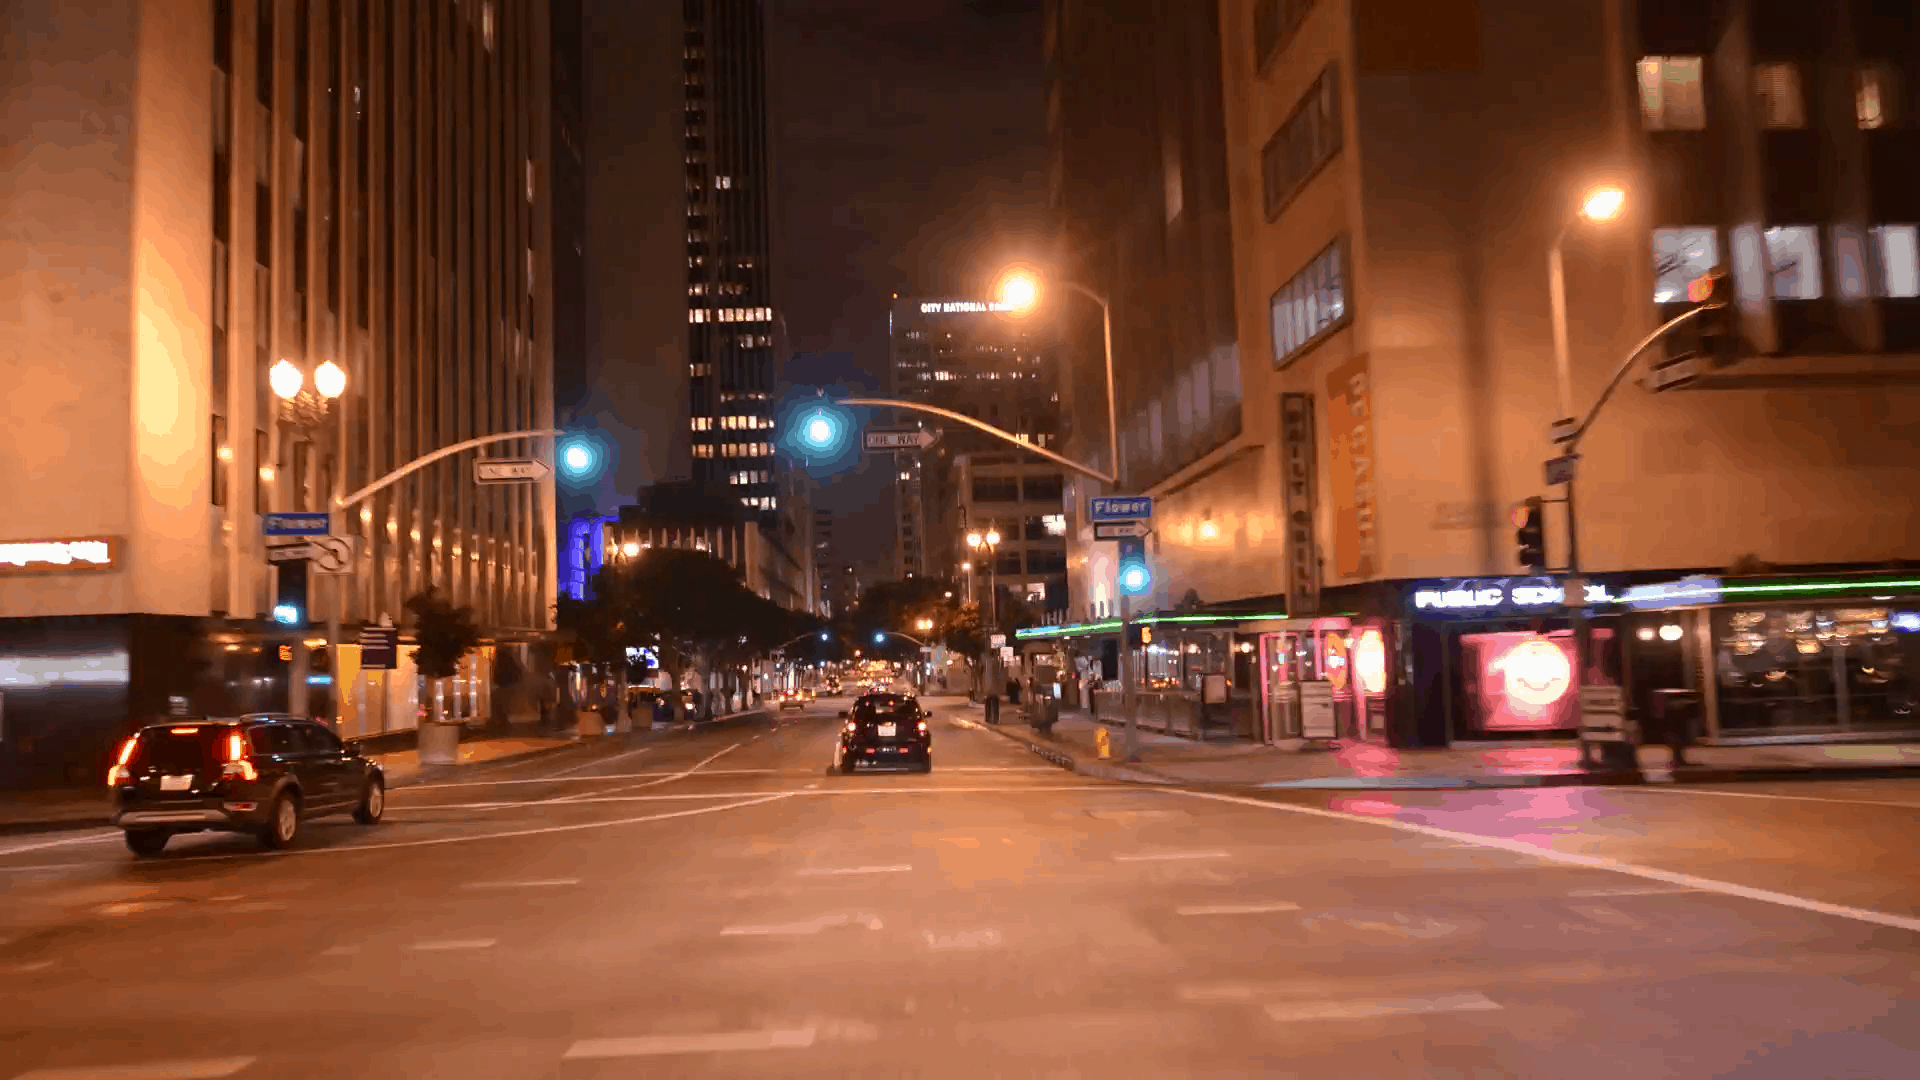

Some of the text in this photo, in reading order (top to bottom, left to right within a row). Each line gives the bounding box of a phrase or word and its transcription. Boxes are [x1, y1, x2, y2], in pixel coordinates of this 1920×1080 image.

[921, 302, 942, 313] CITY
[943, 301, 987, 313] NATIONAL
[1094, 500, 1147, 514] Flower
[1415, 588, 1504, 608] PUBLIC
